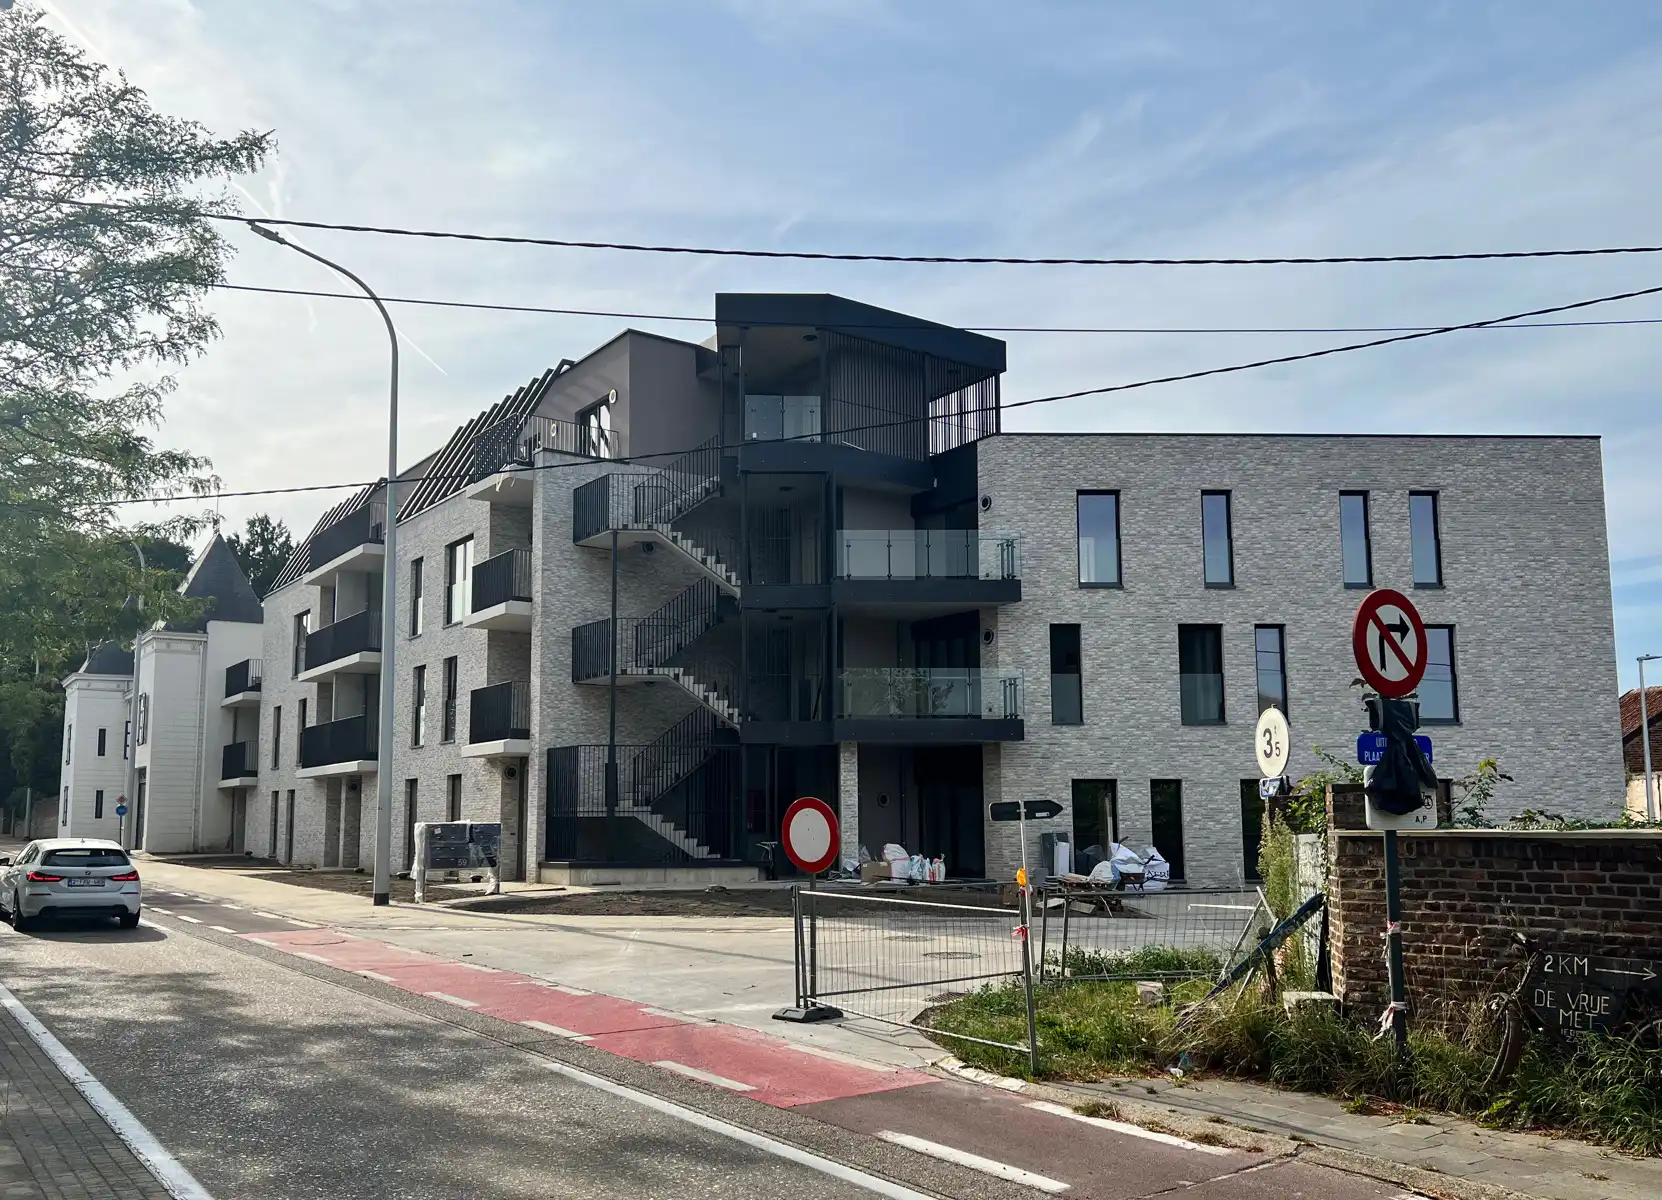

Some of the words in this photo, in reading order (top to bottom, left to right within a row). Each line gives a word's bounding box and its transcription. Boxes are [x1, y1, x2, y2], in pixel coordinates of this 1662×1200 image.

[1534, 988, 1557, 1009] DE
[1567, 992, 1610, 1014] VRIJE
[1559, 1008, 1598, 1029] MET
